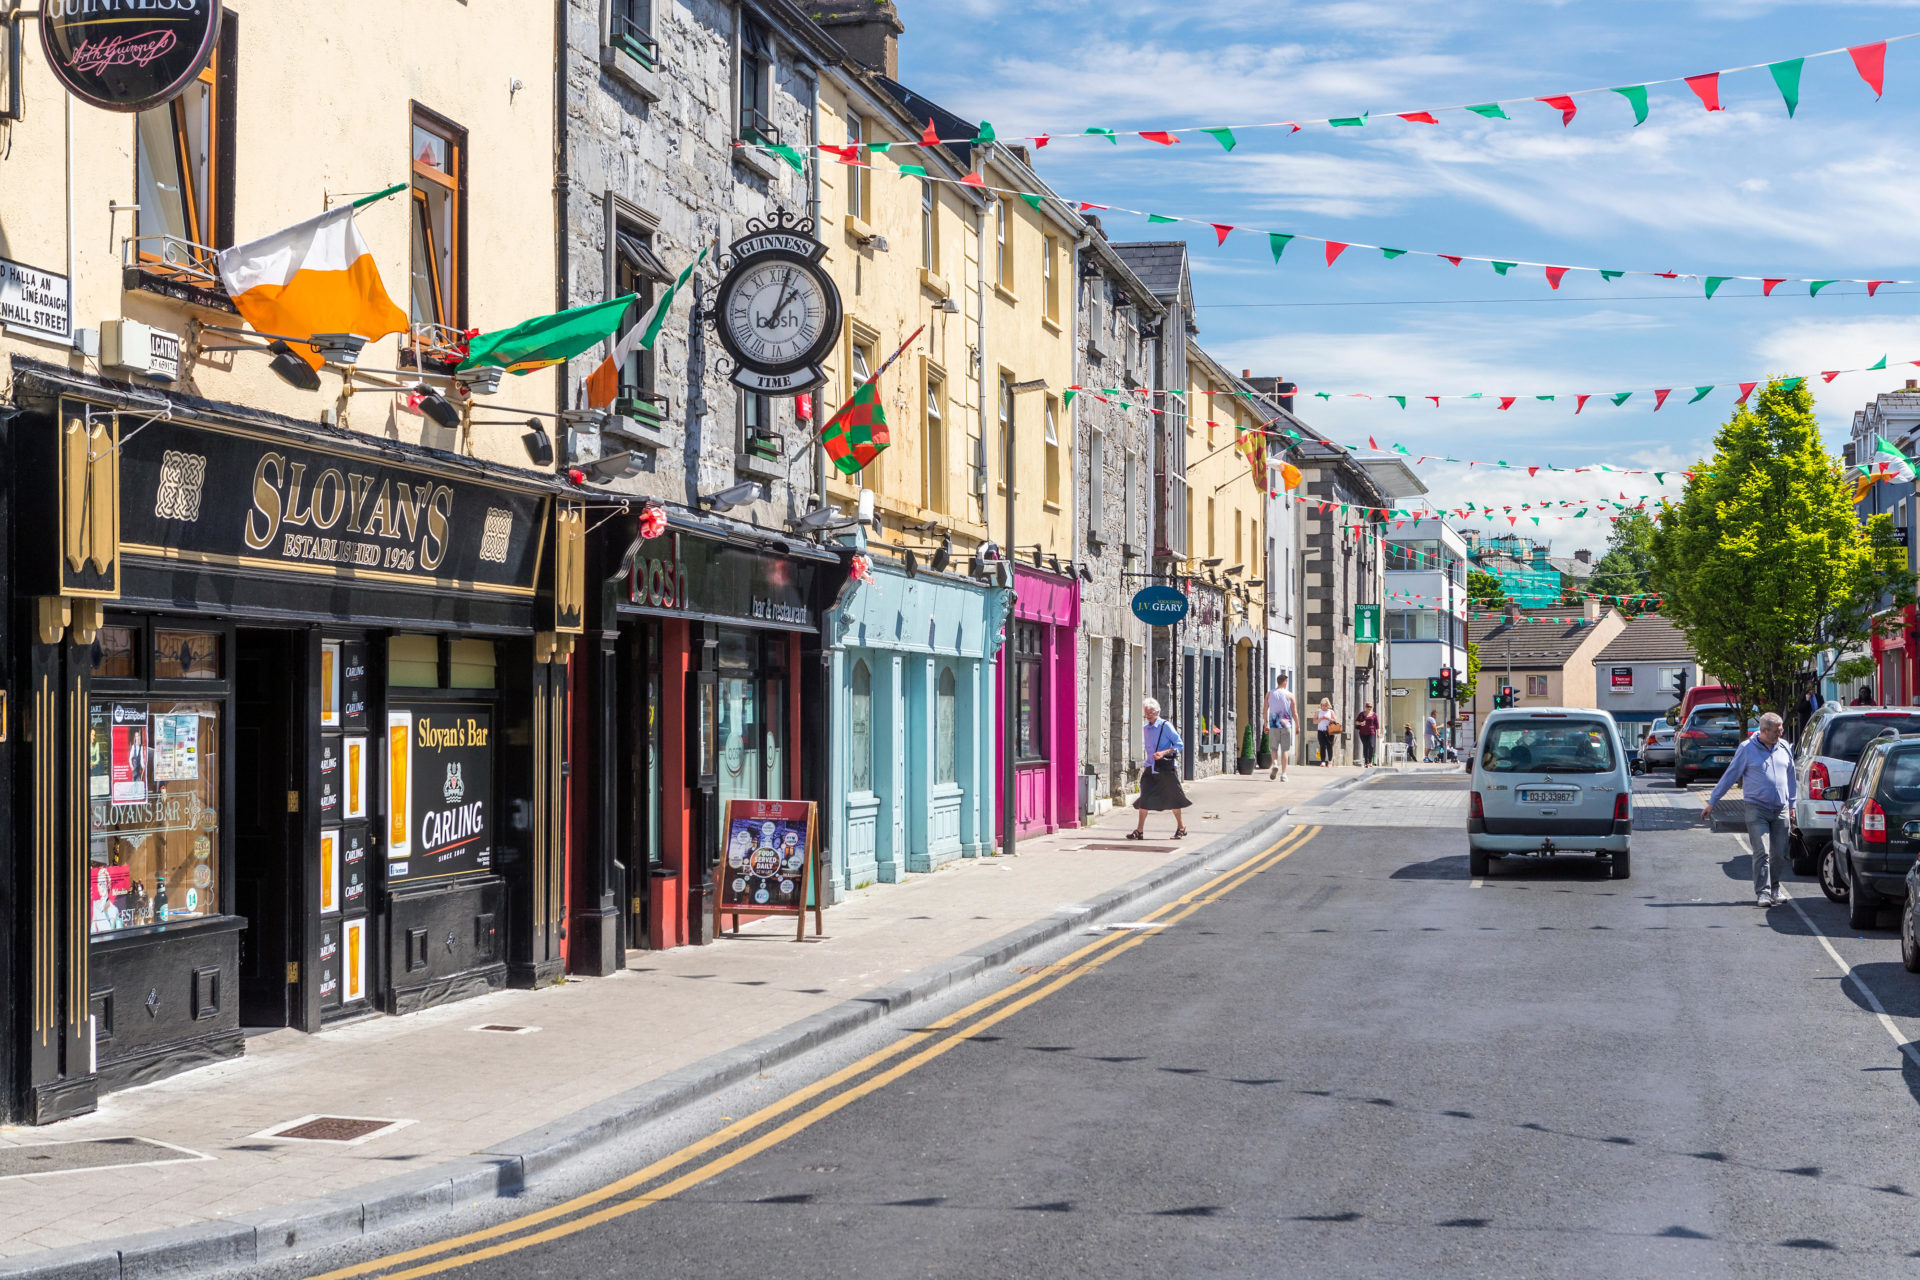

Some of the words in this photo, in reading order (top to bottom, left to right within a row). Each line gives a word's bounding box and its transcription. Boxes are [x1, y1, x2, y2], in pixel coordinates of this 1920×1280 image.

[740, 236, 811, 256] GUINNESS
[10, 267, 36, 287] HALLA
[39, 277, 51, 291] AN
[0, 301, 31, 323] NHALL
[34, 310, 67, 332] STREET
[756, 309, 799, 329] bosh
[757, 376, 792, 389] TIME
[244, 451, 454, 571] SLOYAN'S
[282, 533, 382, 567] ESTABLISHED
[383, 547, 415, 571] 1926
[752, 595, 765, 618] bar
[772, 600, 807, 625] restaurant
[1152, 602, 1183, 611] GEARY
[418, 718, 466, 754] Sloyan's
[467, 719, 488, 747] Bar
[93, 802, 153, 827] SLOYAN'S
[155, 800, 181, 822] BAR
[421, 800, 484, 850] CARLING
[438, 853, 453, 863] SINCE
[754, 856, 777, 864] SERVED
[756, 862, 774, 870] DAILY
